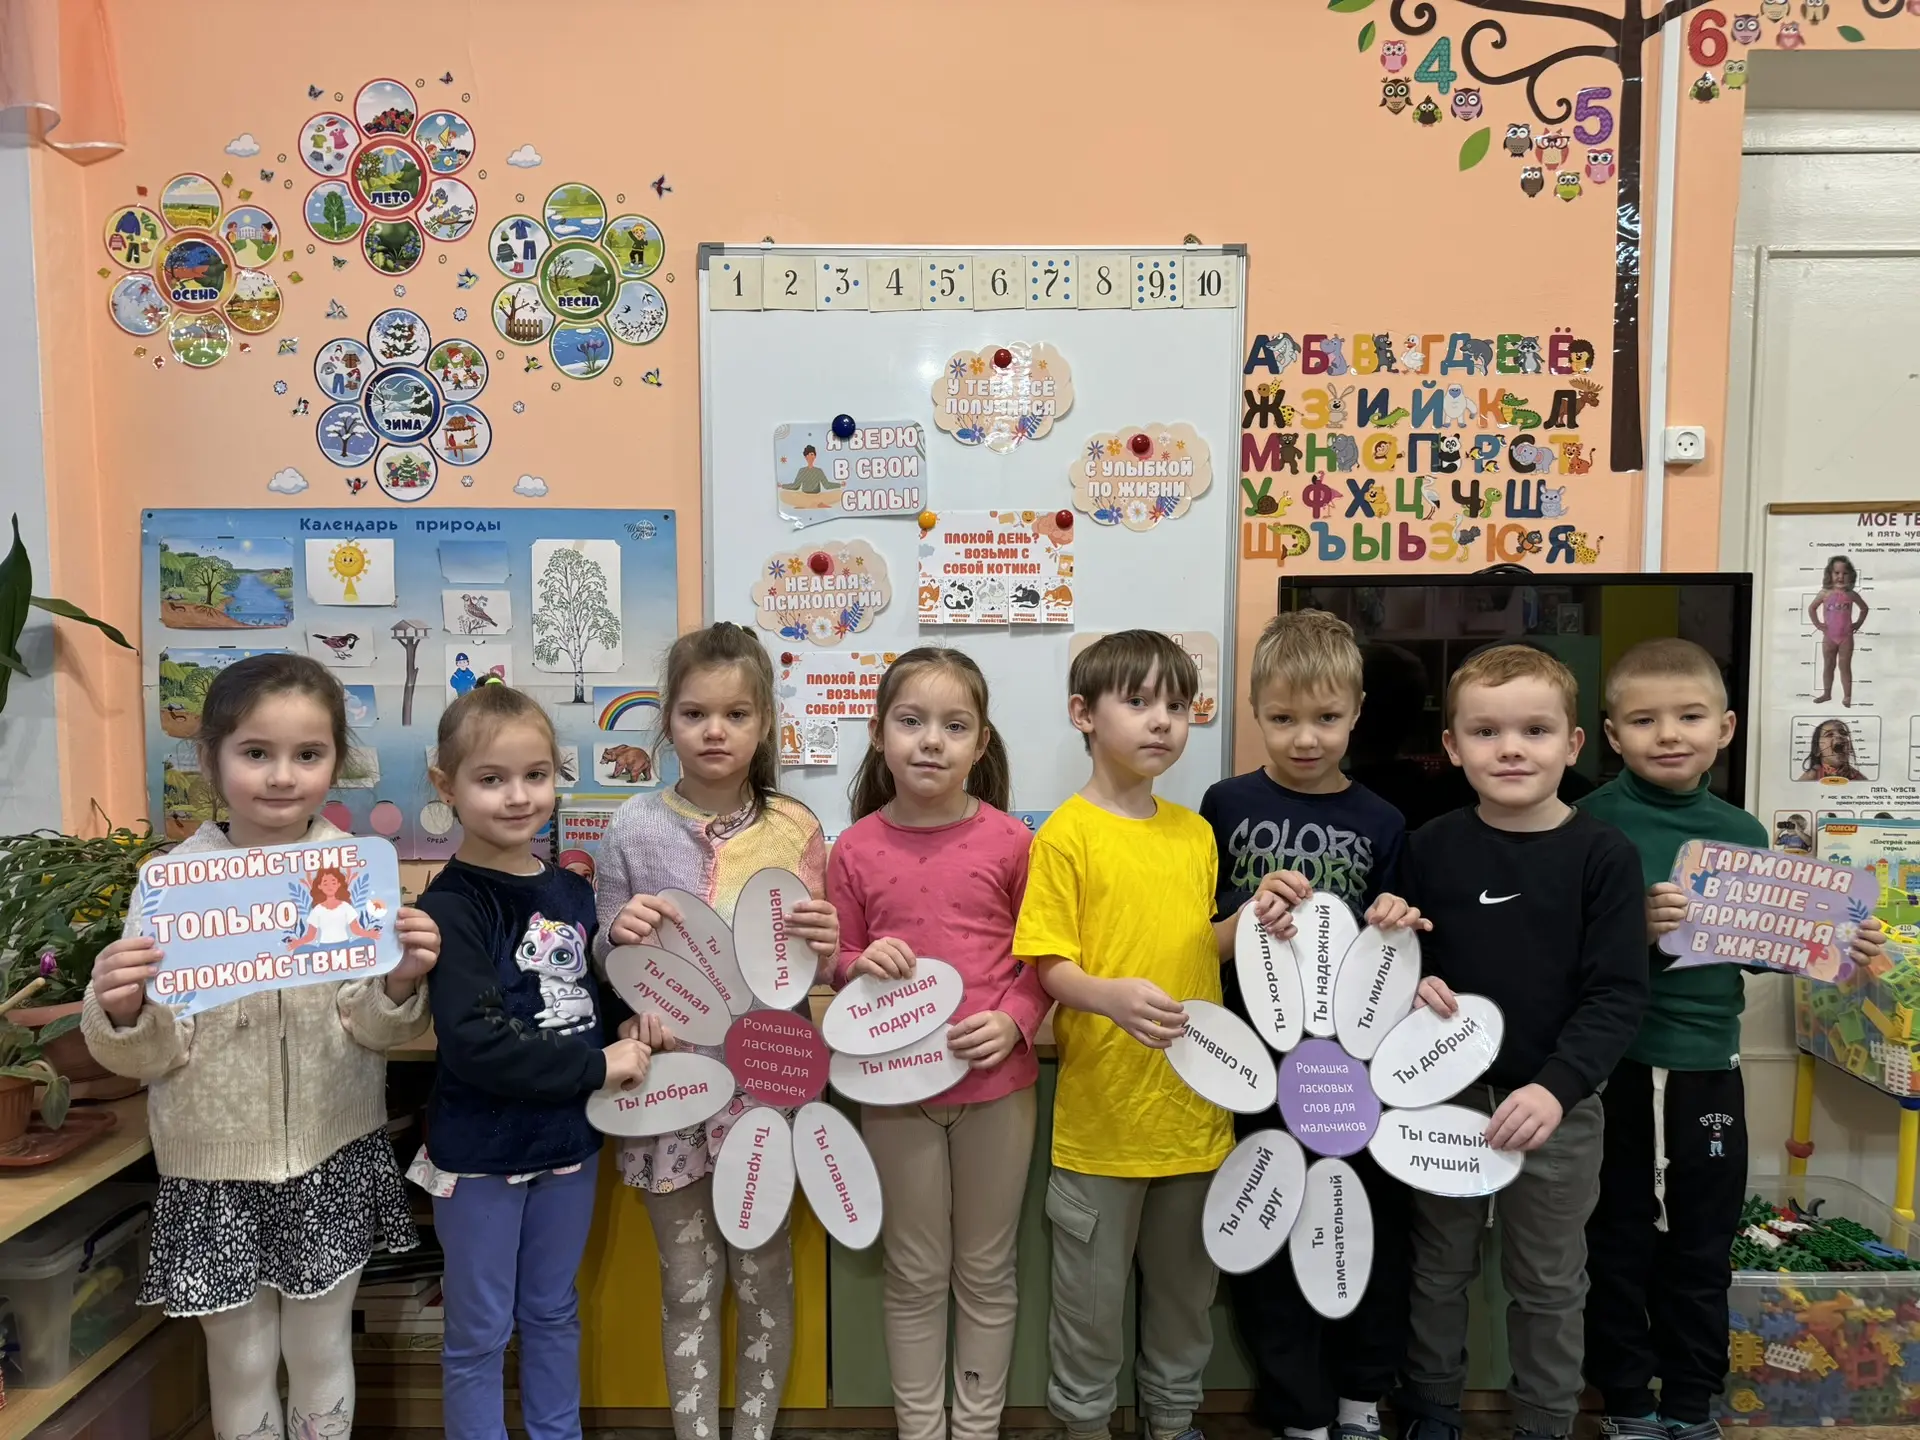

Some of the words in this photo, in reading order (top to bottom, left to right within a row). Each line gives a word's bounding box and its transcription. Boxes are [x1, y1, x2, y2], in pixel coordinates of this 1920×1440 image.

[1687, 9, 1727, 67] 6
[1414, 36, 1457, 95] 4
[1573, 87, 1613, 145] 5
[371, 191, 410, 204] ЛЕТО
[732, 270, 743, 296] 1
[785, 270, 798, 296] 2
[835, 268, 850, 295] 3
[885, 268, 904, 296] 4
[940, 268, 956, 296] 5
[1044, 269, 1059, 297] 7
[1096, 266, 1112, 295] 8
[1197, 270, 1222, 296] 10
[172, 288, 218, 301] ОСЕНЬ
[558, 296, 600, 307] ВЕСНА
[1243, 334, 1279, 375] А
[1302, 334, 1329, 375] Б
[1353, 334, 1379, 375] В
[1421, 334, 1444, 374] Г
[1440, 333, 1474, 376] Д
[1497, 334, 1521, 375] Е
[1550, 327, 1574, 375] Ё
[947, 378, 960, 396] У
[1242, 388, 1286, 429] Ж
[1302, 388, 1330, 429] З
[1357, 388, 1389, 428] И
[1411, 380, 1444, 428] Й
[1478, 388, 1506, 428] К
[1543, 389, 1580, 429] Л
[385, 419, 422, 431] ЗИМА
[826, 430, 843, 451] Я
[849, 426, 918, 450] ВЕРЮ
[1241, 433, 1281, 472] М
[1306, 433, 1337, 473] Н
[1362, 433, 1398, 472] О
[1408, 433, 1441, 473] П
[1474, 434, 1500, 474] Р
[1508, 434, 1535, 473] С
[1549, 435, 1580, 474] Т
[833, 459, 849, 480] В
[856, 456, 918, 479] СВОИ
[1085, 460, 1097, 477] С
[1102, 456, 1193, 477] УЛЫБКОЙ
[841, 487, 919, 511] СИЛЫ!
[1088, 481, 1112, 498] ПО
[1118, 481, 1186, 497] ЖИЗНИ
[1241, 477, 1273, 517] У
[1302, 480, 1332, 519] Ф
[1345, 478, 1375, 518] Х
[1396, 477, 1424, 519] Ц
[1452, 480, 1480, 518] Ч
[1505, 479, 1545, 518] Ш
[300, 518, 398, 533] Календарь
[416, 519, 501, 533] природы
[1857, 513, 1897, 526] МОЕ
[944, 530, 994, 544] ПЛОХОЙ
[997, 532, 1040, 545] ДЕНЬ?
[1243, 522, 1284, 567] Щ
[1310, 522, 1346, 561] Ъ
[1353, 522, 1391, 561] Ы
[1399, 522, 1427, 561] Ь
[1429, 522, 1457, 562] Э
[1486, 523, 1530, 563] Ю
[1546, 525, 1576, 564] Я
[964, 548, 1018, 559] ВОЗЬМИ
[1021, 548, 1029, 559] С
[943, 561, 984, 574] СОБОЙ
[987, 563, 1041, 574] КОТИКА!
[785, 574, 859, 593] НЕДЕЛЯ
[763, 590, 882, 611] ПСИХОЛОГИИ
[806, 671, 856, 684] ПЛОХОЙ
[805, 701, 846, 714] СОБОЙ
[426, 836, 449, 844] СРЕДА
[1228, 817, 1373, 862] COLORS
[1699, 847, 1854, 894] ГАРМОНИЯ
[1703, 876, 1720, 899] В
[1725, 879, 1810, 912] ДУШЕ
[151, 900, 299, 944] ТОЛЬКО
[769, 889, 788, 961] хорошая
[1685, 901, 1837, 946] ГАРМОНИЯ
[706, 936, 721, 955] Ты
[1315, 904, 1331, 995] надежный
[1692, 931, 1709, 952] В
[1715, 932, 1812, 969] ЖИЗНИ
[155, 944, 377, 995] СПОКОЙСТВИЕ!
[673, 920, 731, 1001] мечательная
[1254, 922, 1280, 1003] хороший
[644, 959, 665, 979] Ты
[665, 978, 710, 1015] самая
[775, 966, 789, 990] Ты
[1358, 1006, 1375, 1029] Ты
[1369, 945, 1397, 1005] милый
[633, 982, 690, 1025] лучшая
[847, 1002, 872, 1019] Ты
[876, 975, 937, 1009] лучшая
[868, 1002, 936, 1038] подруга
[1274, 1009, 1286, 1032] Ты
[1314, 1000, 1327, 1022] Ты
[743, 1017, 812, 1039] Ромашка
[742, 1039, 813, 1059] ласковых
[1392, 1065, 1419, 1084] Ты
[1419, 1017, 1478, 1072] добрый
[744, 1058, 778, 1072] слов
[781, 1065, 809, 1078] для
[859, 1060, 883, 1075] Ты
[888, 1050, 943, 1071] милая
[1296, 1062, 1349, 1074] Ромашка
[744, 1077, 806, 1098] девочек
[1240, 1065, 1258, 1089] Ты
[1299, 1084, 1354, 1093] ласковых
[614, 1096, 640, 1112] Ты
[644, 1081, 708, 1107] добрая
[1303, 1103, 1330, 1113] слов
[1334, 1103, 1356, 1115] для
[1699, 1113, 1734, 1126] STEVE
[754, 1126, 770, 1148] Ты
[1300, 1122, 1367, 1133] мальчиков
[1398, 1124, 1422, 1141] Ты
[1428, 1131, 1489, 1148] самый
[813, 1125, 829, 1150] Ты
[824, 1154, 858, 1223] славная
[1410, 1155, 1480, 1173] лучший
[739, 1152, 762, 1230] красивая
[1219, 1213, 1241, 1236] Ты
[1235, 1146, 1274, 1214] лучший
[1258, 1187, 1283, 1230] друг
[1312, 1227, 1323, 1248] Ты
[1330, 1175, 1347, 1299] замечательный
